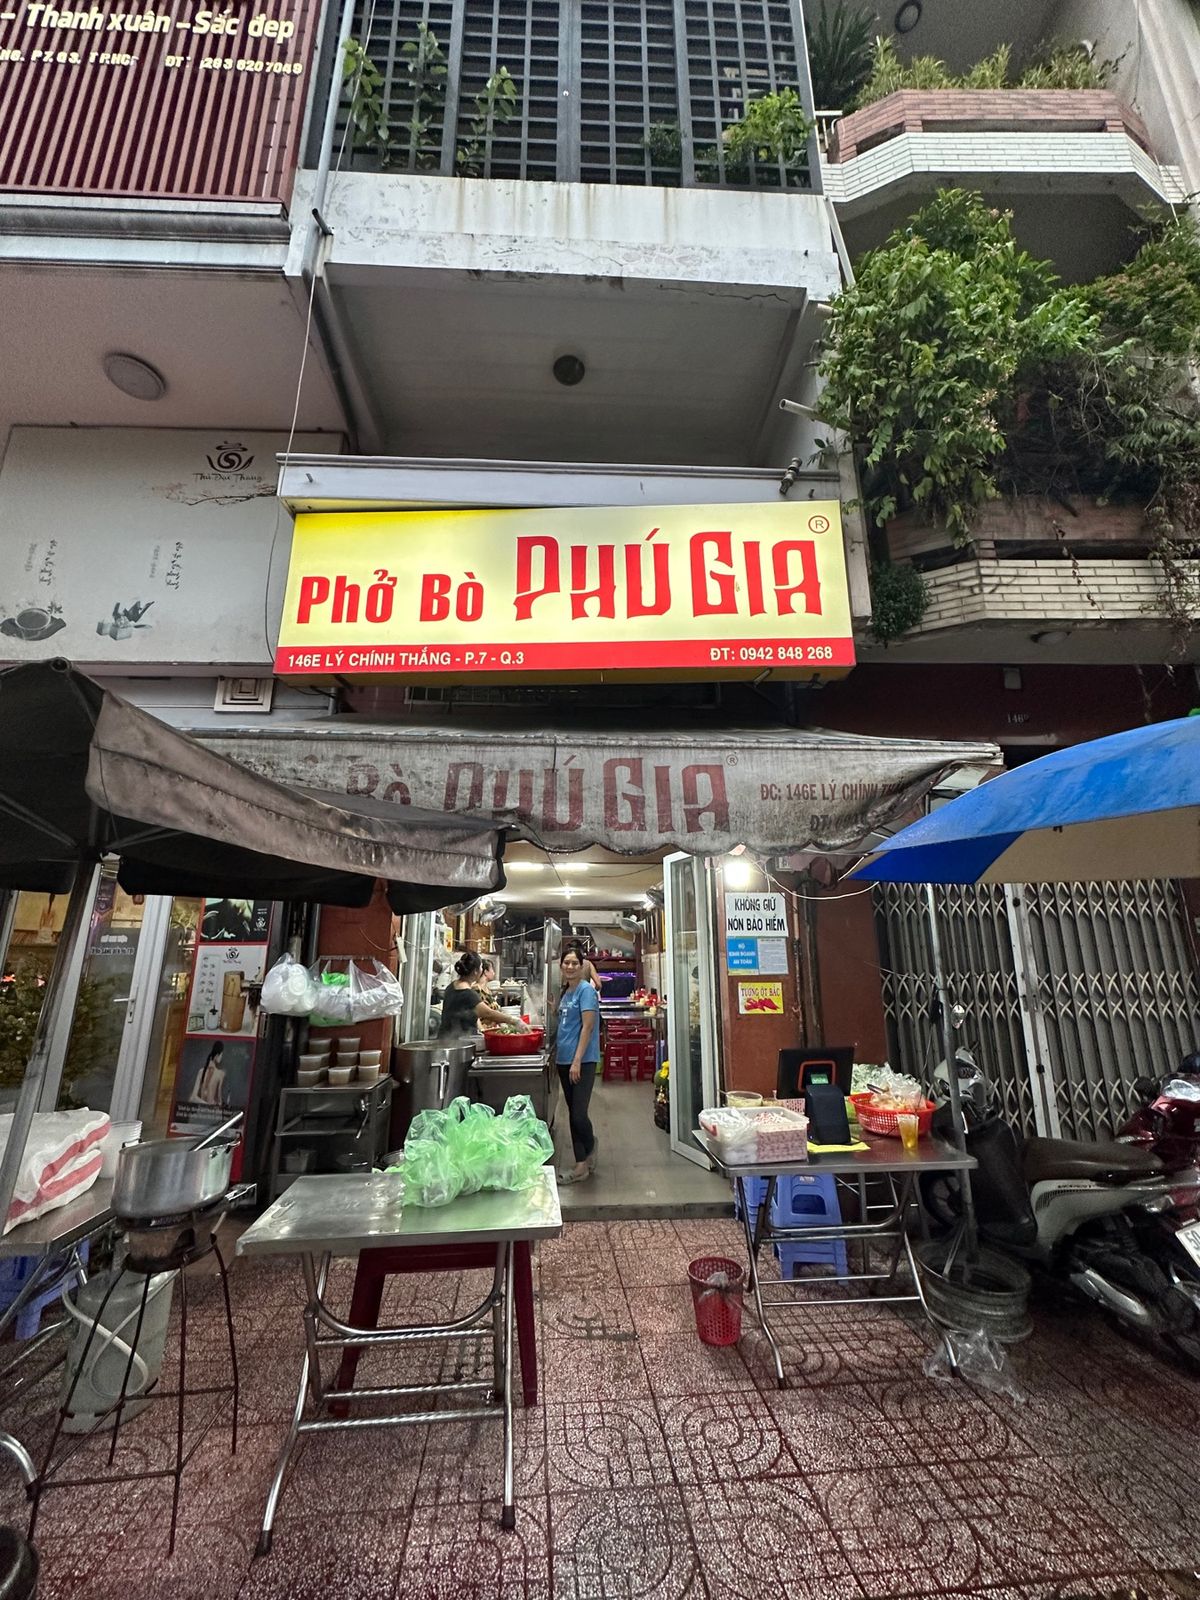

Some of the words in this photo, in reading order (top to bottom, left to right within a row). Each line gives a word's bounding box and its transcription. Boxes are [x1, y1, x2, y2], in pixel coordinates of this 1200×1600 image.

[27, 3, 104, 30] Thanh
[106, 10, 171, 33] xuân
[296, 568, 398, 624] Phở
[419, 571, 485, 622] Bò
[513, 527, 672, 621] PHÚ
[690, 531, 823, 618] GIA
[288, 653, 322, 668] 146E
[325, 649, 345, 667] LÝ
[348, 649, 395, 667] CHÍNH
[399, 646, 452, 666] THẮNG
[464, 651, 488, 665] P.7
[500, 650, 525, 665] Q.3
[709, 646, 736, 661] ĐT:
[739, 646, 775, 661] 0942
[777, 645, 804, 660] 848
[806, 645, 834, 660] 268
[602, 757, 731, 834] GIA
[786, 783, 817, 801] 146E
[821, 779, 836, 801] LÝ
[841, 780, 879, 801] CHÍNH
[734, 896, 761, 911] KHÔNG
[727, 914, 744, 931] NÓN
[746, 914, 763, 931] BẢO
[765, 912, 785, 931] HIỂM
